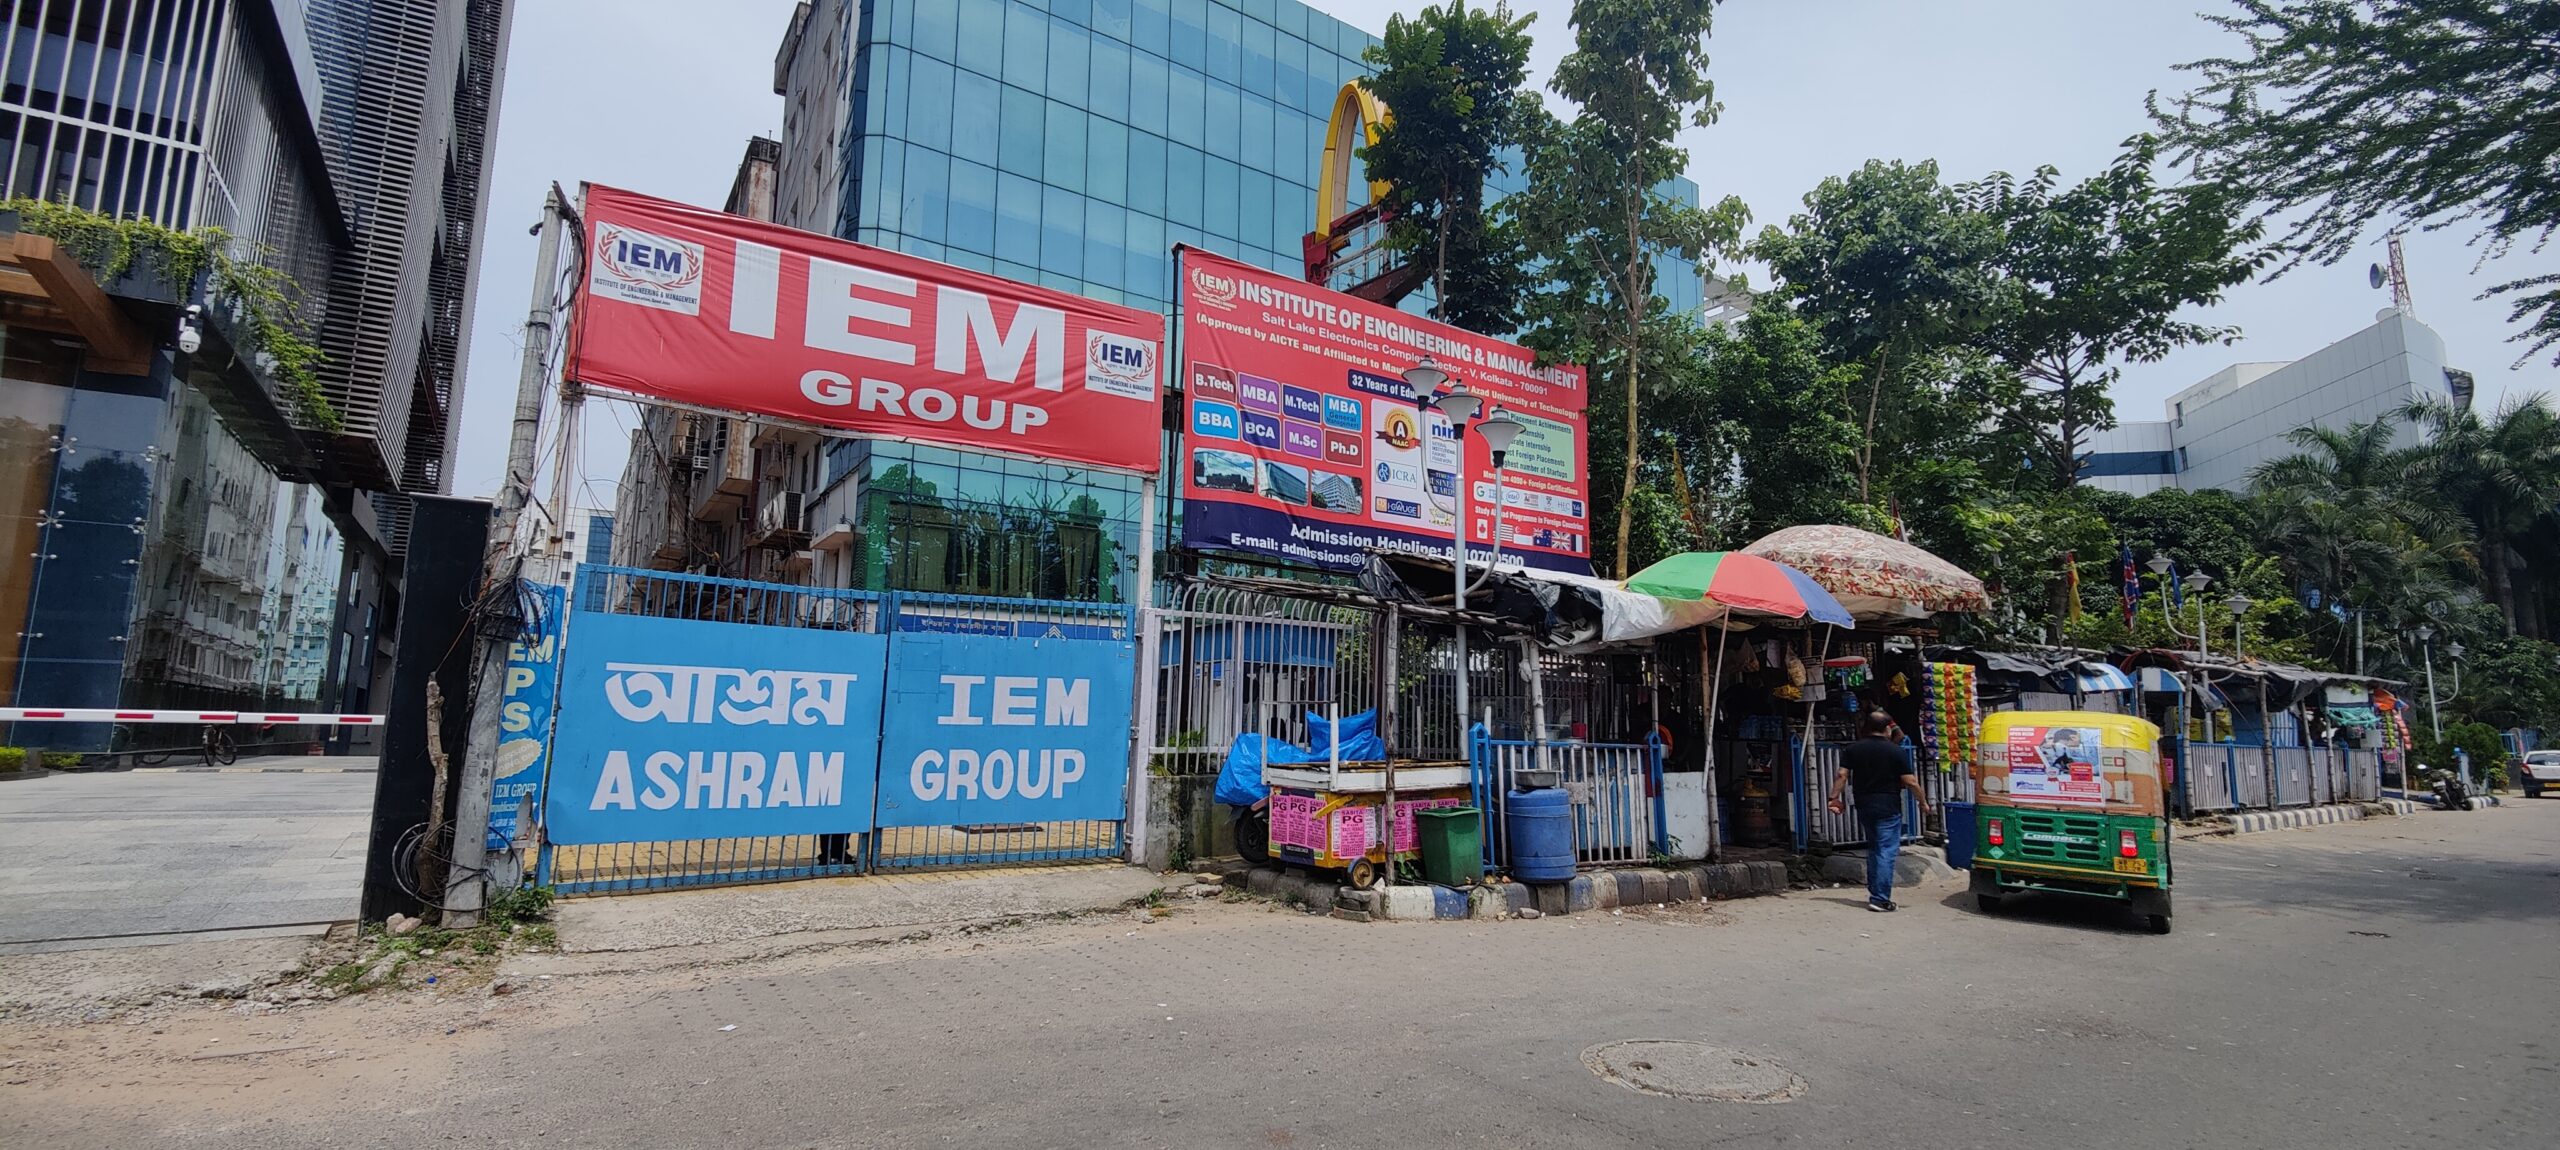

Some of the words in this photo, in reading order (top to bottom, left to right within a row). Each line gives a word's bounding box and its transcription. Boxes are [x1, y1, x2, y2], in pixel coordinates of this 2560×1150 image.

[618, 240, 682, 274] IEM
[594, 277, 619, 290] INSTITUTE
[627, 284, 659, 298] ENGINEERING
[665, 292, 698, 305] MANAGEMENT
[1200, 272, 1229, 293] IEM
[729, 240, 1065, 393] IEM
[1239, 279, 1337, 325] INSTITUTE
[1339, 308, 1362, 331] OF
[1364, 317, 1472, 363] ENGINEERING
[1475, 348, 1485, 366] &
[1487, 350, 1579, 390] MANAGEMENT
[1102, 342, 1143, 368] IEM
[1262, 312, 1285, 327] Salt
[1288, 317, 1316, 335] Lake
[1318, 326, 1379, 352] Electronics
[1432, 358, 1462, 374] Sector
[1469, 368, 1478, 380] V,
[1480, 371, 1513, 388] Kolkata
[1519, 381, 1548, 396] 700091
[1196, 312, 1251, 336] (Approved
[1254, 328, 1267, 342] by
[1269, 332, 1300, 349] AICTE
[1302, 341, 1321, 355] and
[1323, 347, 1368, 367] Affiliated
[1370, 357, 1380, 369] to
[1471, 386, 1490, 398] Azad
[1491, 390, 1528, 409] University
[1530, 399, 1538, 409] of
[1539, 401, 1579, 421] Technology)
[1195, 373, 1234, 393] B.Tech
[1351, 374, 1364, 387] 32
[1365, 377, 1388, 393] Years
[1389, 385, 1399, 395] of
[799, 369, 1049, 435] GROUP
[1242, 384, 1278, 405] MBA
[1284, 395, 1320, 414] M.Tech
[1329, 398, 1357, 415] MBA
[1329, 411, 1357, 422] General
[1199, 412, 1233, 429] BBA
[1245, 421, 1275, 440] BCA
[1395, 421, 1406, 438] A
[1432, 419, 1456, 440] nir
[1539, 420, 1572, 434] Achievements
[1288, 431, 1317, 448] M.Sc
[1330, 441, 1359, 456] Ph.D
[1392, 438, 1409, 447] NAAC
[1516, 450, 1535, 462] Foreign
[1537, 454, 1565, 467] Placements
[1392, 469, 1417, 483] ICRA
[1520, 463, 1539, 473] number
[1547, 467, 1568, 479] Startups
[1476, 486, 1485, 497] G
[1231, 532, 1279, 551] E-mail:
[1282, 542, 1366, 566] admissions@i
[1291, 523, 1373, 549] Admission
[1377, 535, 1442, 557] Helpline:
[505, 667, 536, 697] P
[604, 661, 858, 726] আশ্রম
[937, 674, 1090, 726] IEM
[501, 701, 531, 732] S
[589, 750, 845, 811] ASHRAM
[910, 748, 1086, 801] GROUP
[495, 784, 510, 798] IEM
[1272, 801, 1287, 811] PG
[1290, 802, 1306, 813] PG
[1395, 809, 1406, 818] G
[1342, 815, 1363, 824] PG
